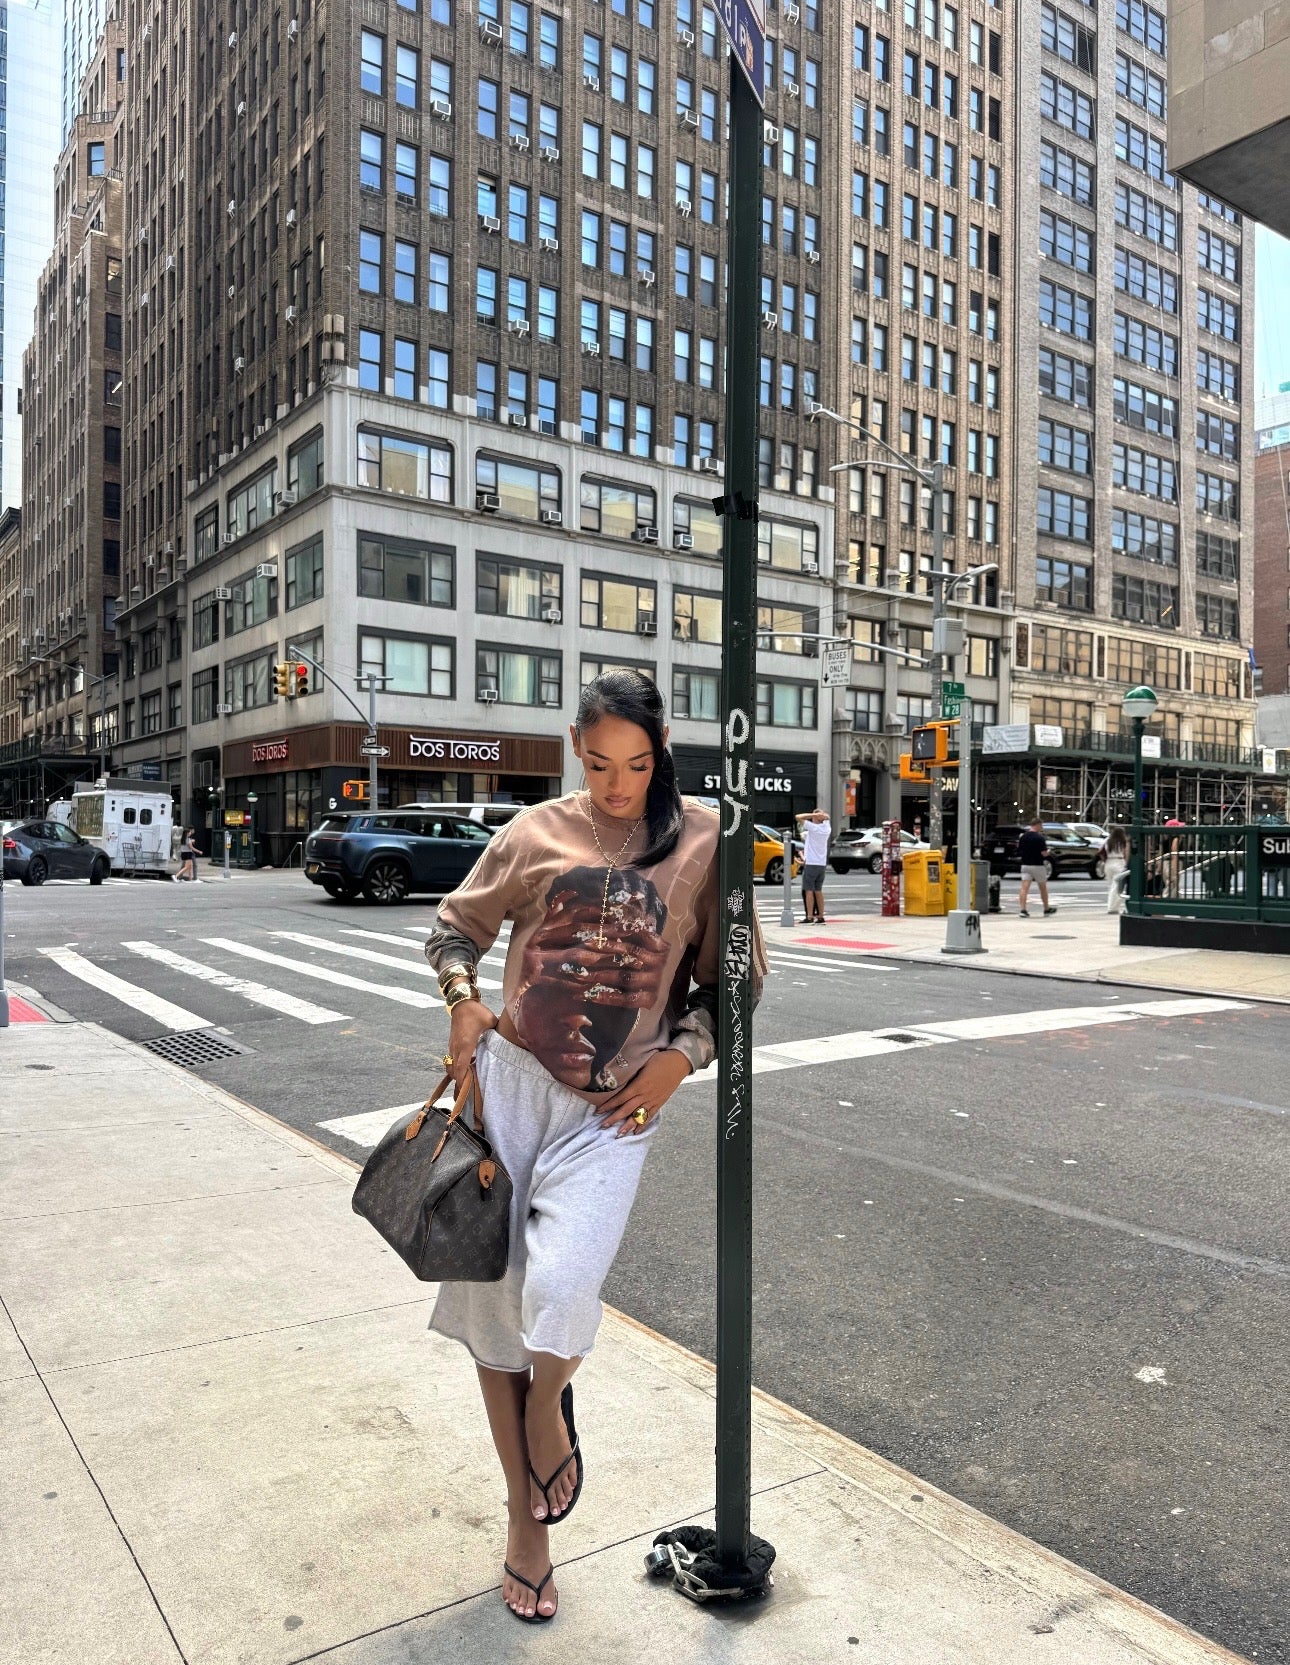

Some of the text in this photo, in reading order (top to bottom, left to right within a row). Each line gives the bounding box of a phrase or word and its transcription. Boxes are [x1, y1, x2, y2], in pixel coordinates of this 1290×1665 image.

[828, 651, 847, 661] BUSES
[829, 664, 844, 673] ONLY
[252, 747, 266, 762] DOS
[409, 740, 500, 761] DOS TOROS
[704, 774, 792, 792] STUCKS
[940, 777, 959, 791] CAV
